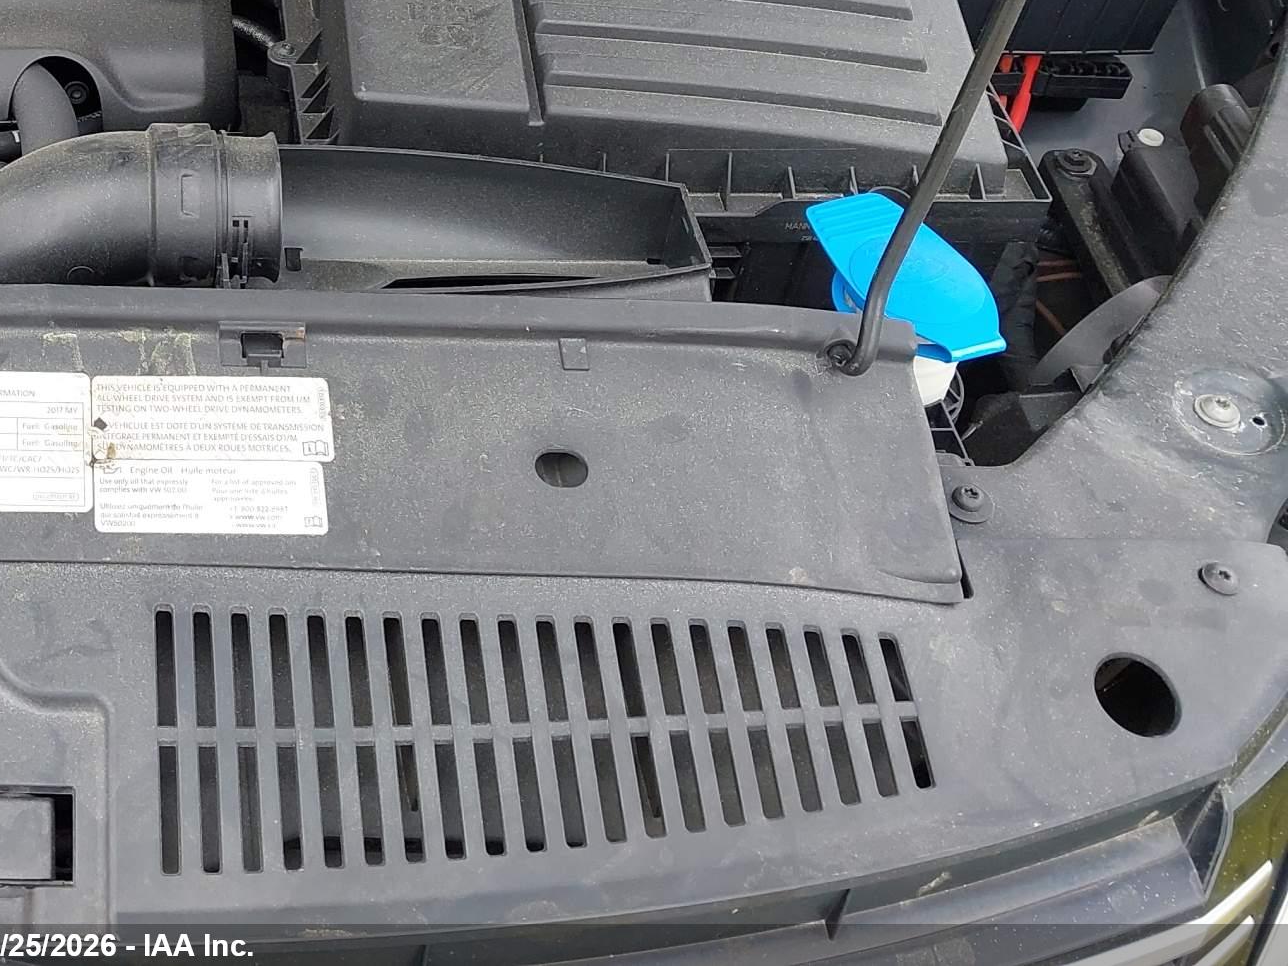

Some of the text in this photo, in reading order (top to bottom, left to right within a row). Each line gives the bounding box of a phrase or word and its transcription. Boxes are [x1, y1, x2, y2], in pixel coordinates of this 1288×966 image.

[96, 383, 291, 393] THIS VEHICLE IS EQUIPPED WITH A PERMANENT
[96, 394, 143, 402] ALL-WHEEL
[144, 394, 170, 402] DRIVE
[172, 394, 203, 403] SYSTEM
[205, 394, 224, 403] AND
[226, 395, 234, 403] IS
[236, 395, 268, 403] EXEMPT
[270, 395, 295, 403] FROM
[47, 406, 63, 414] 2017
[64, 406, 78, 414] MY
[96, 404, 132, 413] TESTING
[133, 405, 147, 413] ON
[149, 405, 202, 413] TWO-WHEEL
[204, 405, 231, 413] DRIVE
[150, 421, 164, 430] EST
[250, 422, 262, 431] DE
[263, 422, 324, 432] TRANSMISSION
[142, 432, 190, 441] PERMANENT
[192, 432, 202, 441] ET
[193, 443, 217, 452] DEUX
[218, 443, 246, 453] ROUES
[247, 444, 292, 453] MOTRICES.
[130, 466, 237, 476] Engine Oil Huile moteur
[99, 477, 112, 485] Use
[113, 477, 129, 487] only
[99, 486, 131, 494] complies
